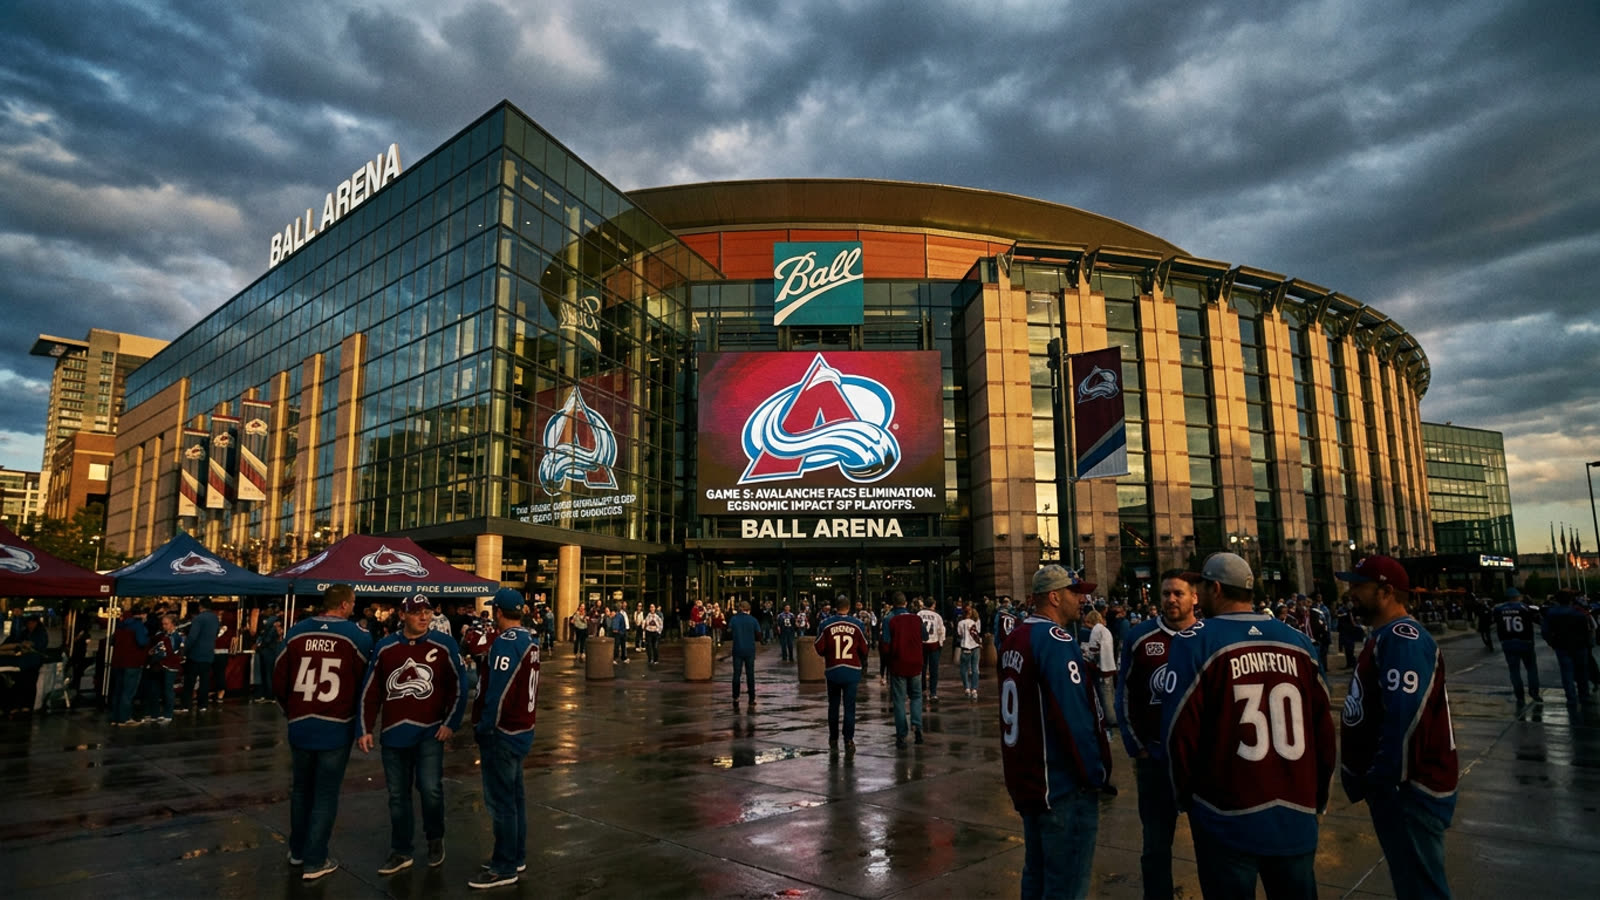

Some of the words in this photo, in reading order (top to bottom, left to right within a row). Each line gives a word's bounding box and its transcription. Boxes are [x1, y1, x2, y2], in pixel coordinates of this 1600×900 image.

[269, 208, 319, 268] BALL
[320, 143, 402, 233] ARENA
[774, 247, 863, 303] Ball
[706, 489, 740, 500] GAME
[755, 488, 825, 499] AVALANCHE
[827, 488, 857, 498] FACS
[859, 487, 936, 498] ELIMINATION.
[791, 500, 834, 511] IMPACT
[854, 499, 916, 510] PLAYOFFS.
[741, 519, 807, 539] BALL
[813, 518, 904, 538] ARENA
[833, 635, 853, 659] 12
[494, 655, 510, 671] 16
[1067, 660, 1081, 684] 8
[293, 657, 342, 703] 45
[1386, 668, 1419, 694] 99
[1232, 682, 1306, 762] 30
